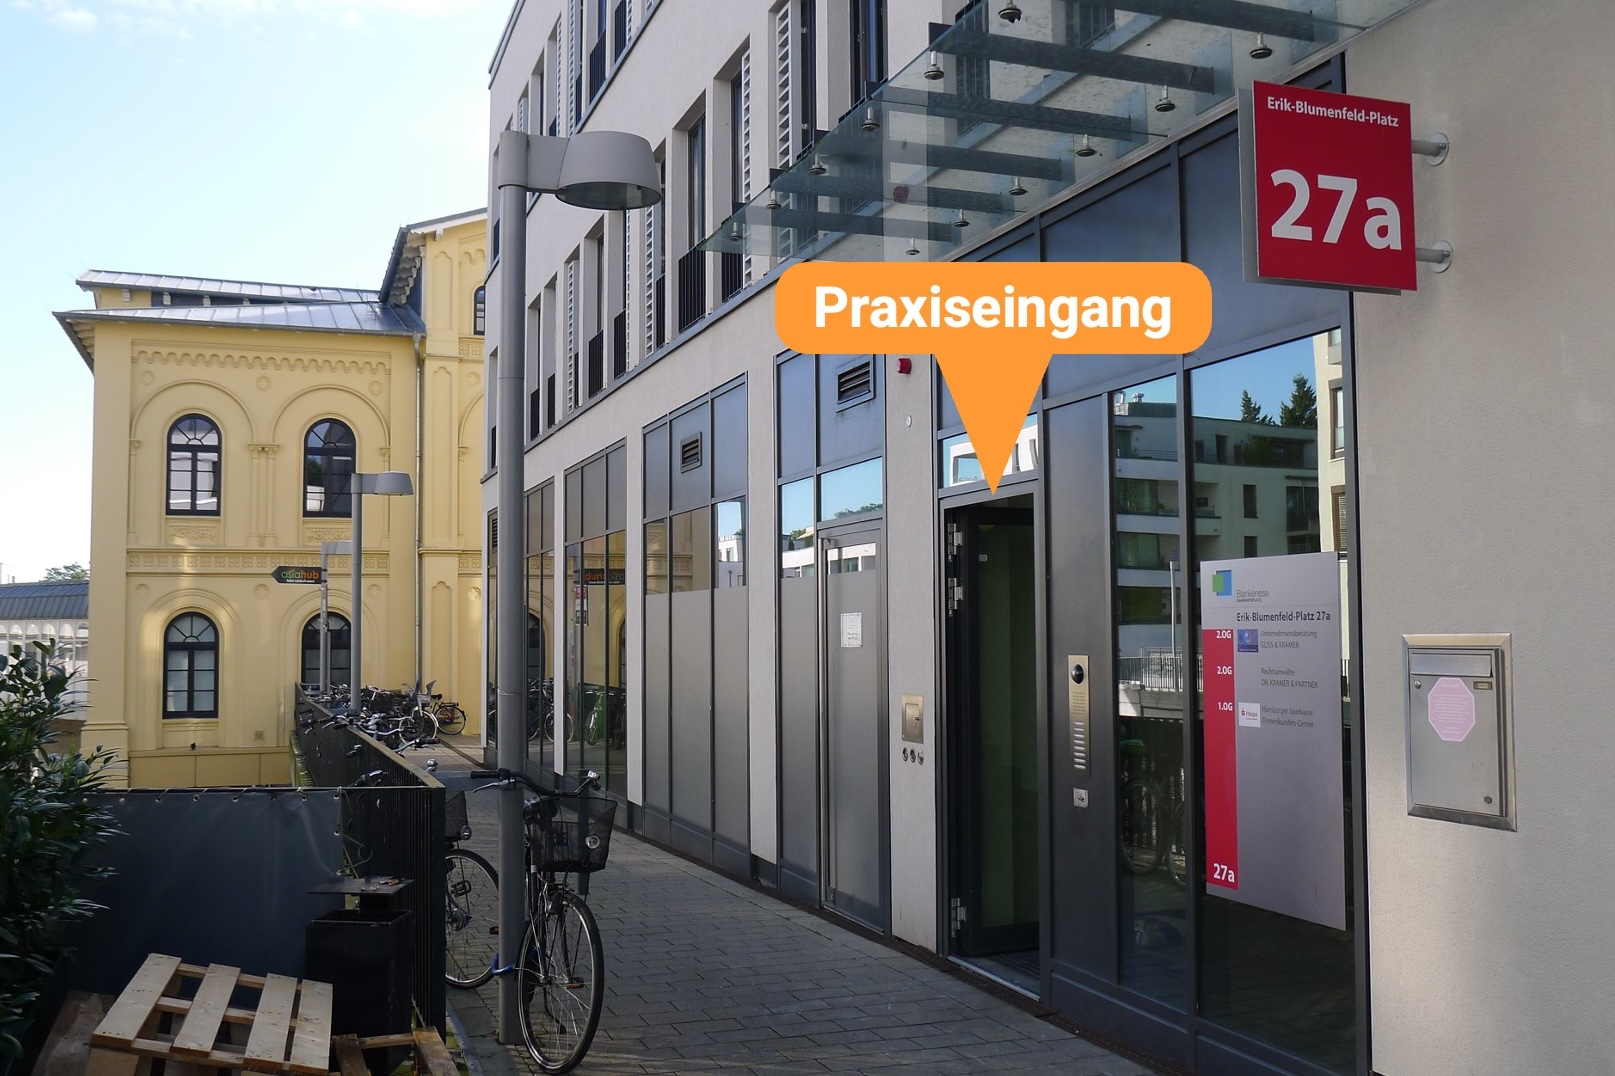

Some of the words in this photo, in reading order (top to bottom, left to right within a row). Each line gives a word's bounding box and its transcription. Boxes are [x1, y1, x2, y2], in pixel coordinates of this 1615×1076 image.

[1267, 96, 1399, 128] Erik-Blumenfeld-Platz
[1270, 168, 1402, 251] 27a
[281, 570, 319, 580] asiahub
[1236, 589, 1269, 598] Blankenese
[1236, 611, 1315, 621] Erik-Blumenfeld-Platz
[1316, 611, 1331, 621] 27a
[1260, 630, 1318, 639] Unternehmensberatung
[1260, 641, 1274, 649] GLISS
[1274, 641, 1279, 649] &
[1279, 641, 1300, 649] KRAMER
[1261, 667, 1295, 676] Rechtsanwälte
[1269, 679, 1290, 688] KRAMER
[1295, 680, 1319, 689] PARTNER
[1262, 705, 1288, 716] Hamburger
[1289, 707, 1314, 717] Sparkasse
[1262, 716, 1314, 728] Firmenkunden-Center
[1213, 862, 1235, 883] 27a
